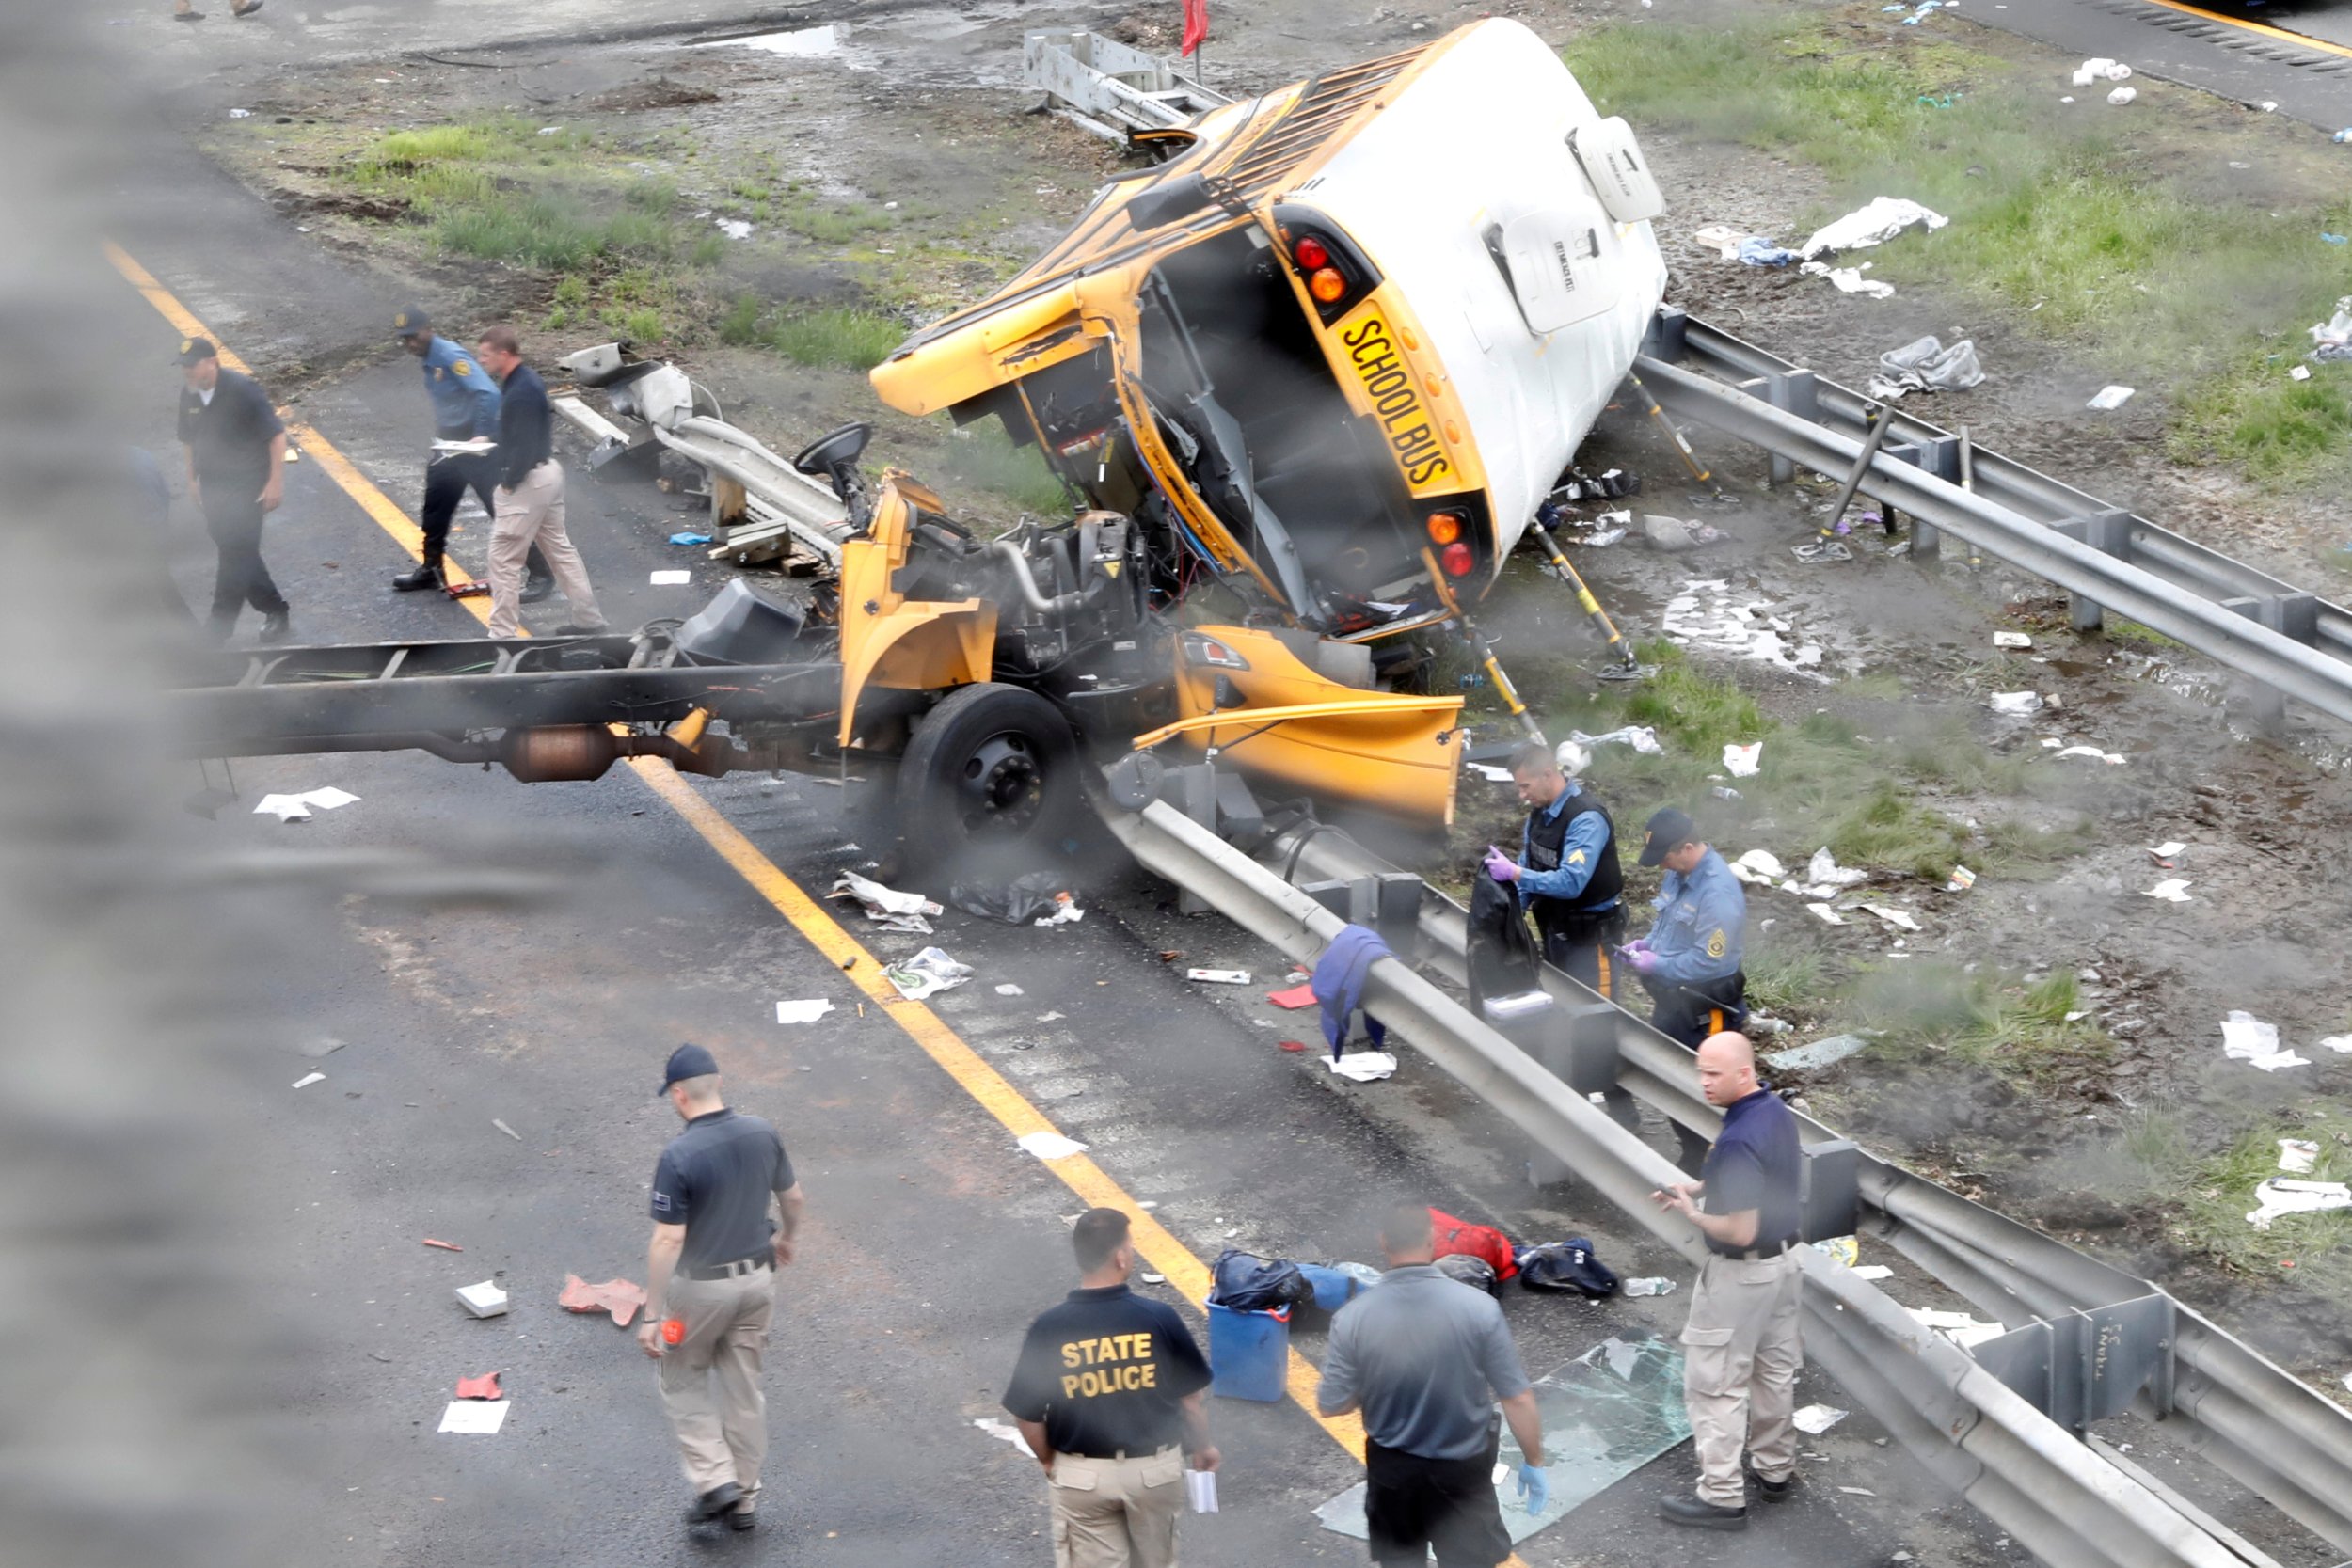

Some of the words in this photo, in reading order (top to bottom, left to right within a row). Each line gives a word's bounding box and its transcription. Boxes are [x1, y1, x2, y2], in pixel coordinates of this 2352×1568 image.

[1343, 319, 1421, 434] SCHOOL
[1392, 423, 1449, 485] BUS
[1060, 1333, 1152, 1368] STATE
[1060, 1363, 1156, 1399] POLICE
